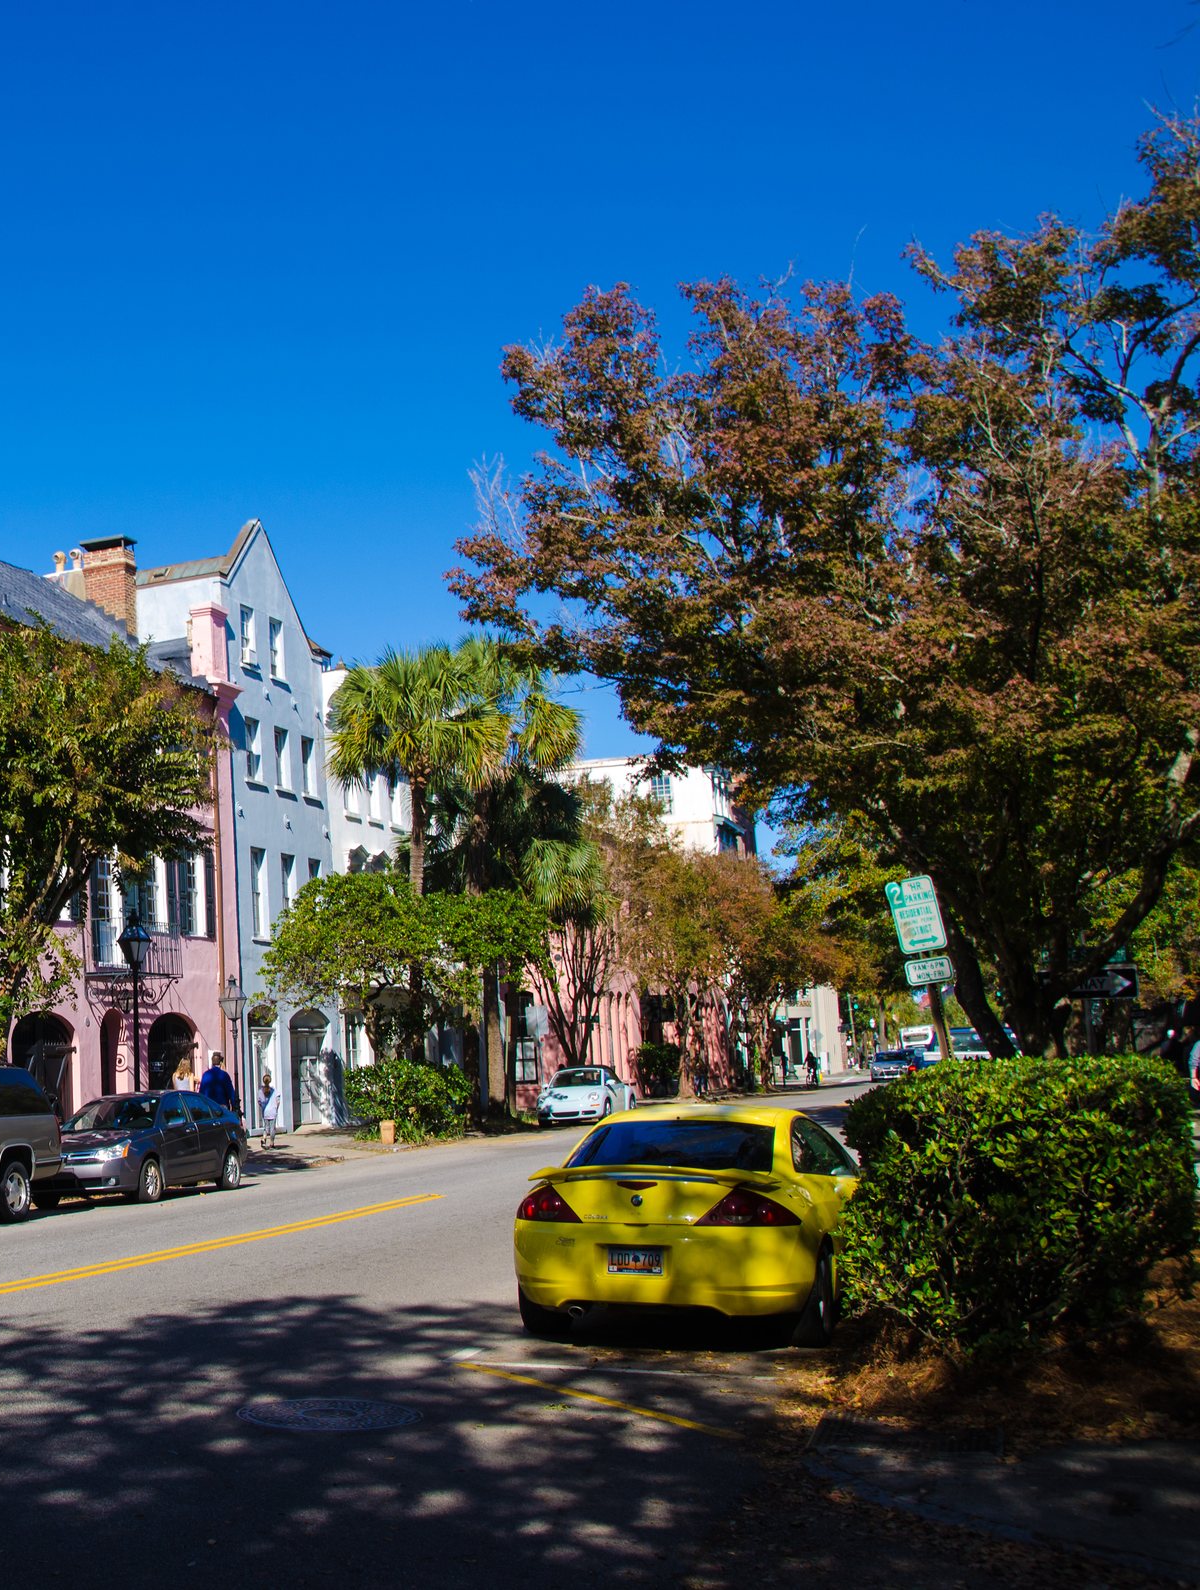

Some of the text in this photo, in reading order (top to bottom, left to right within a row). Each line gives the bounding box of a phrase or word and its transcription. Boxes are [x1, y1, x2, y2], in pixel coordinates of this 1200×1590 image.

[890, 882, 922, 904] 2 HR
[905, 890, 933, 903] PARKING
[899, 905, 932, 919] RESIDENTIAL
[913, 962, 945, 971] 9AM-6PM
[916, 971, 945, 979] MON-FRI
[641, 1253, 661, 1267] 709
